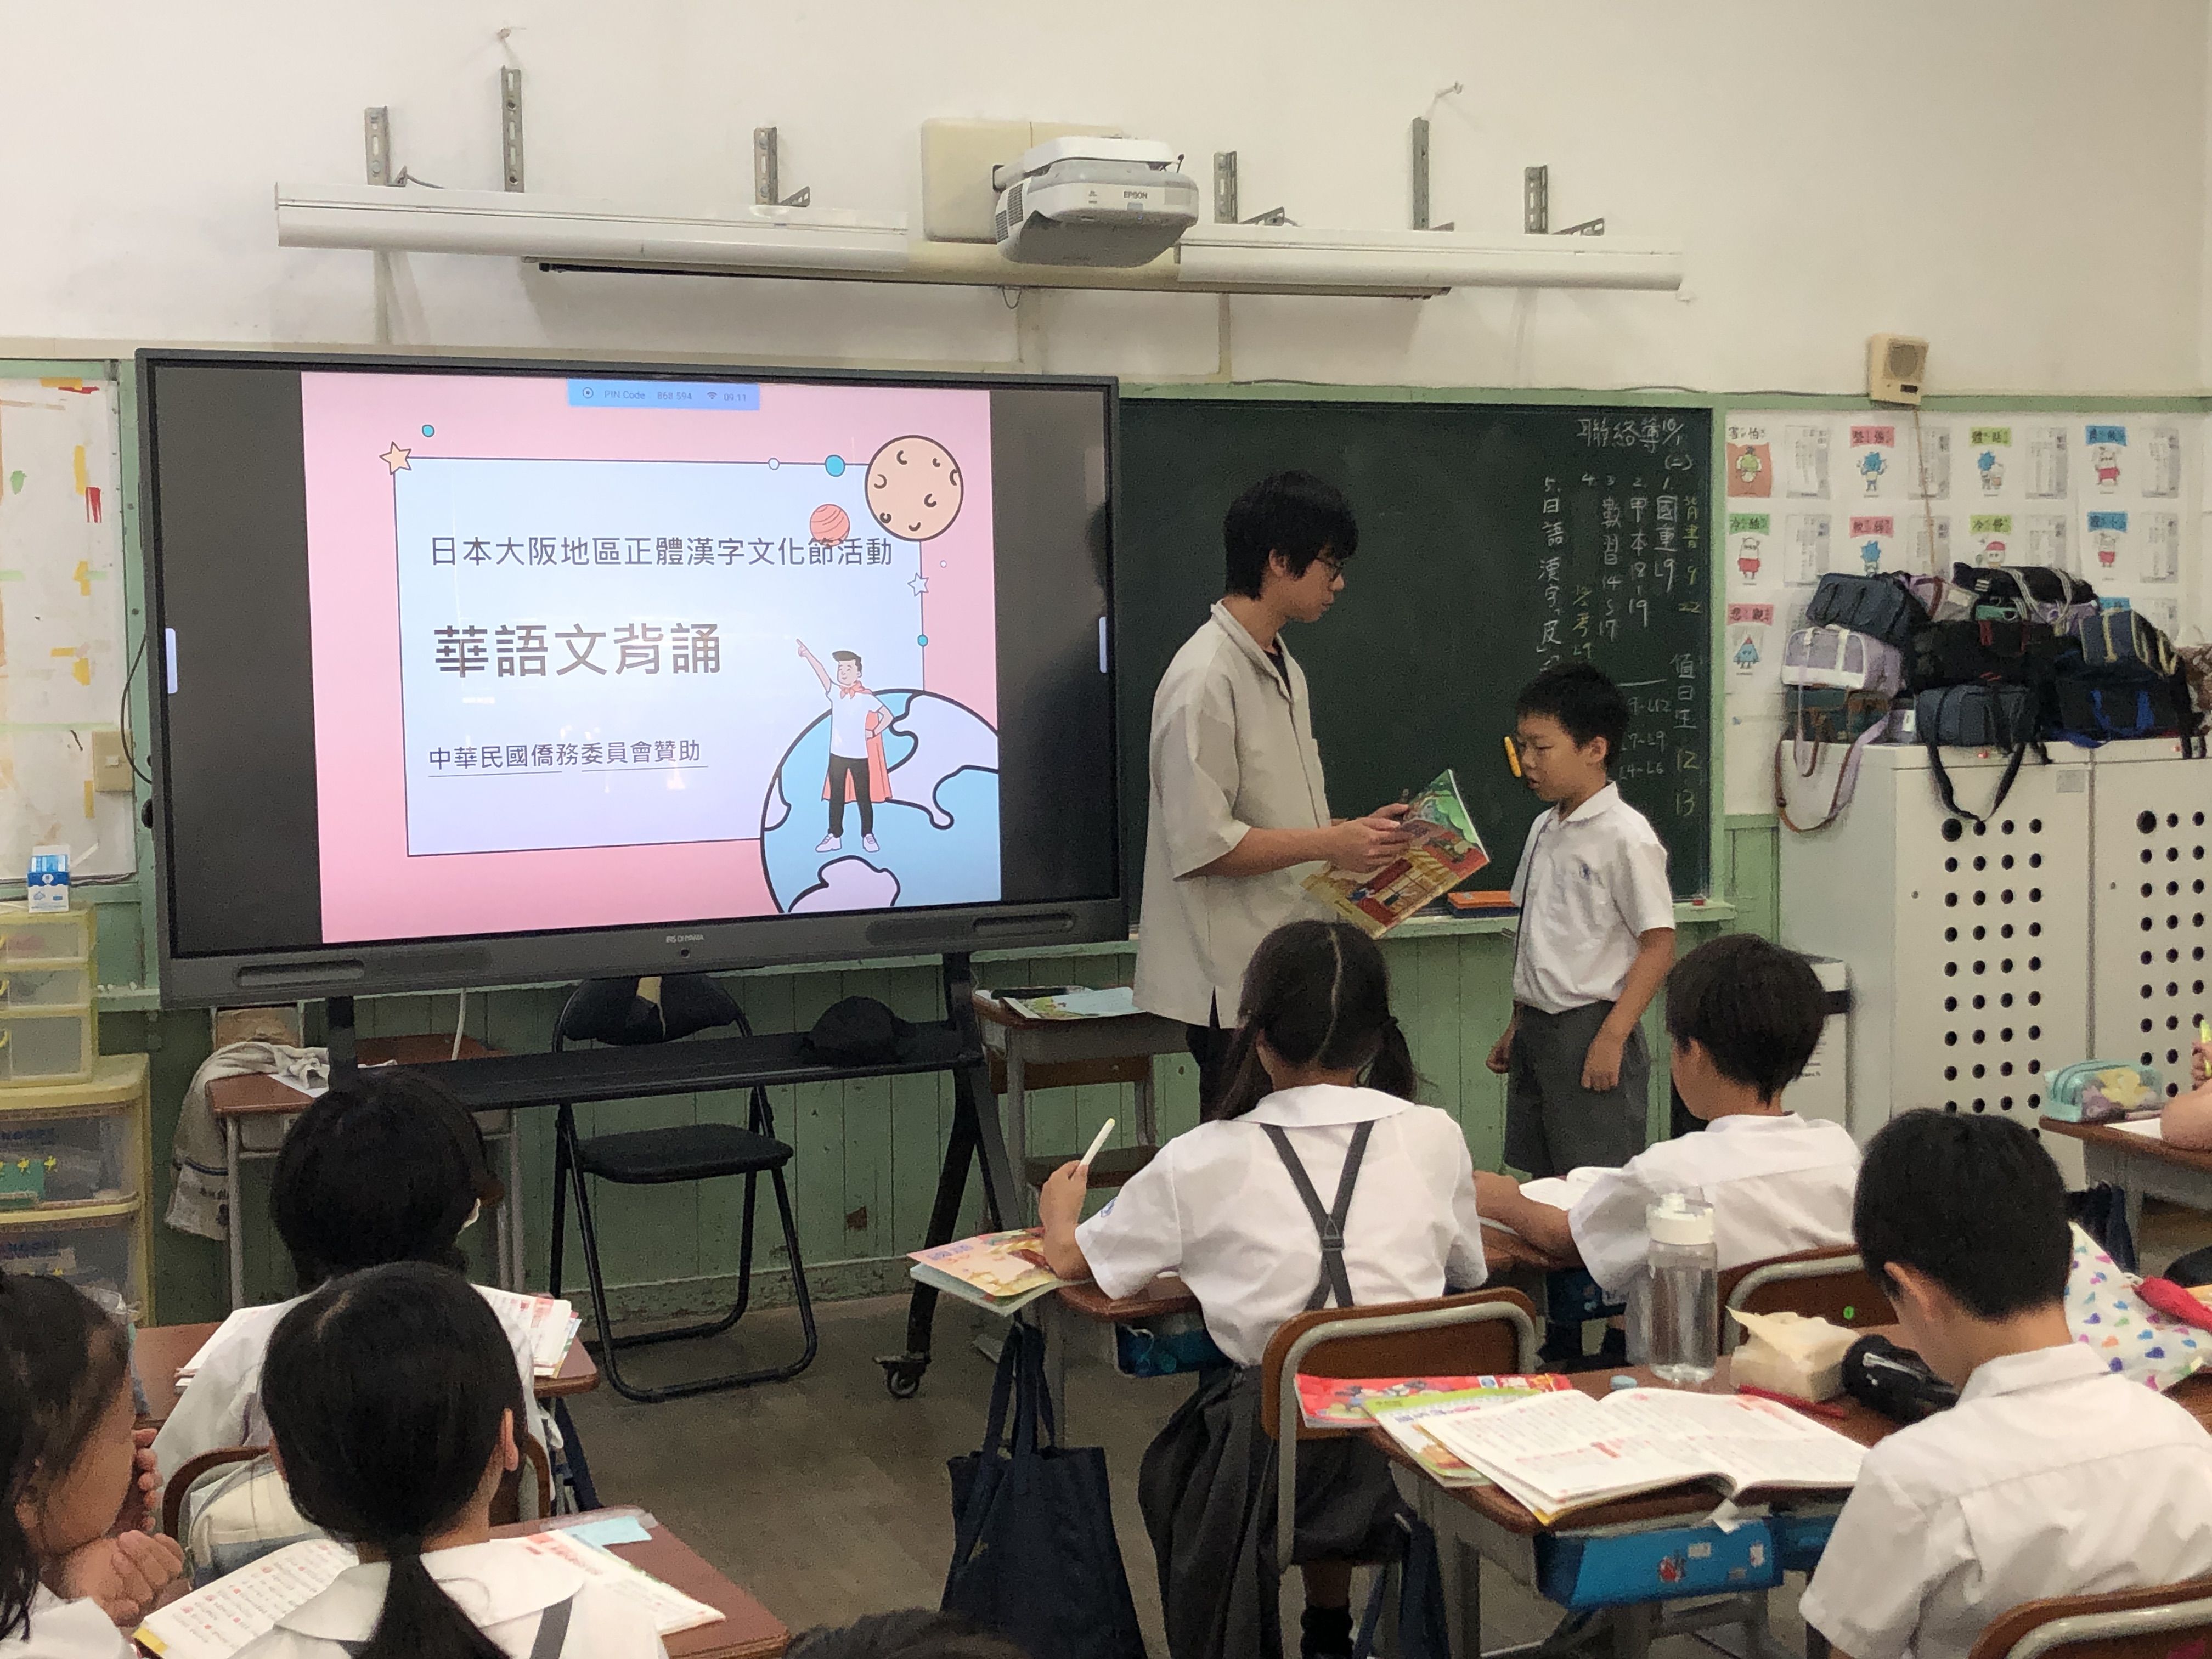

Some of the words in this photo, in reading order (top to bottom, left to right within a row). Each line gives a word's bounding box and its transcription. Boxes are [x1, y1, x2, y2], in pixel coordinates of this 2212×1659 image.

[1123, 191, 1148, 199] EPSON
[605, 390, 620, 399] PIN
[623, 391, 646, 399] Code
[676, 392, 692, 400] 594
[431, 536, 893, 567] 日本大阪地區正體漢字文化節活動
[433, 623, 721, 678] 華語文背誦
[429, 738, 702, 771] 中華民國僑務委員會贊助
